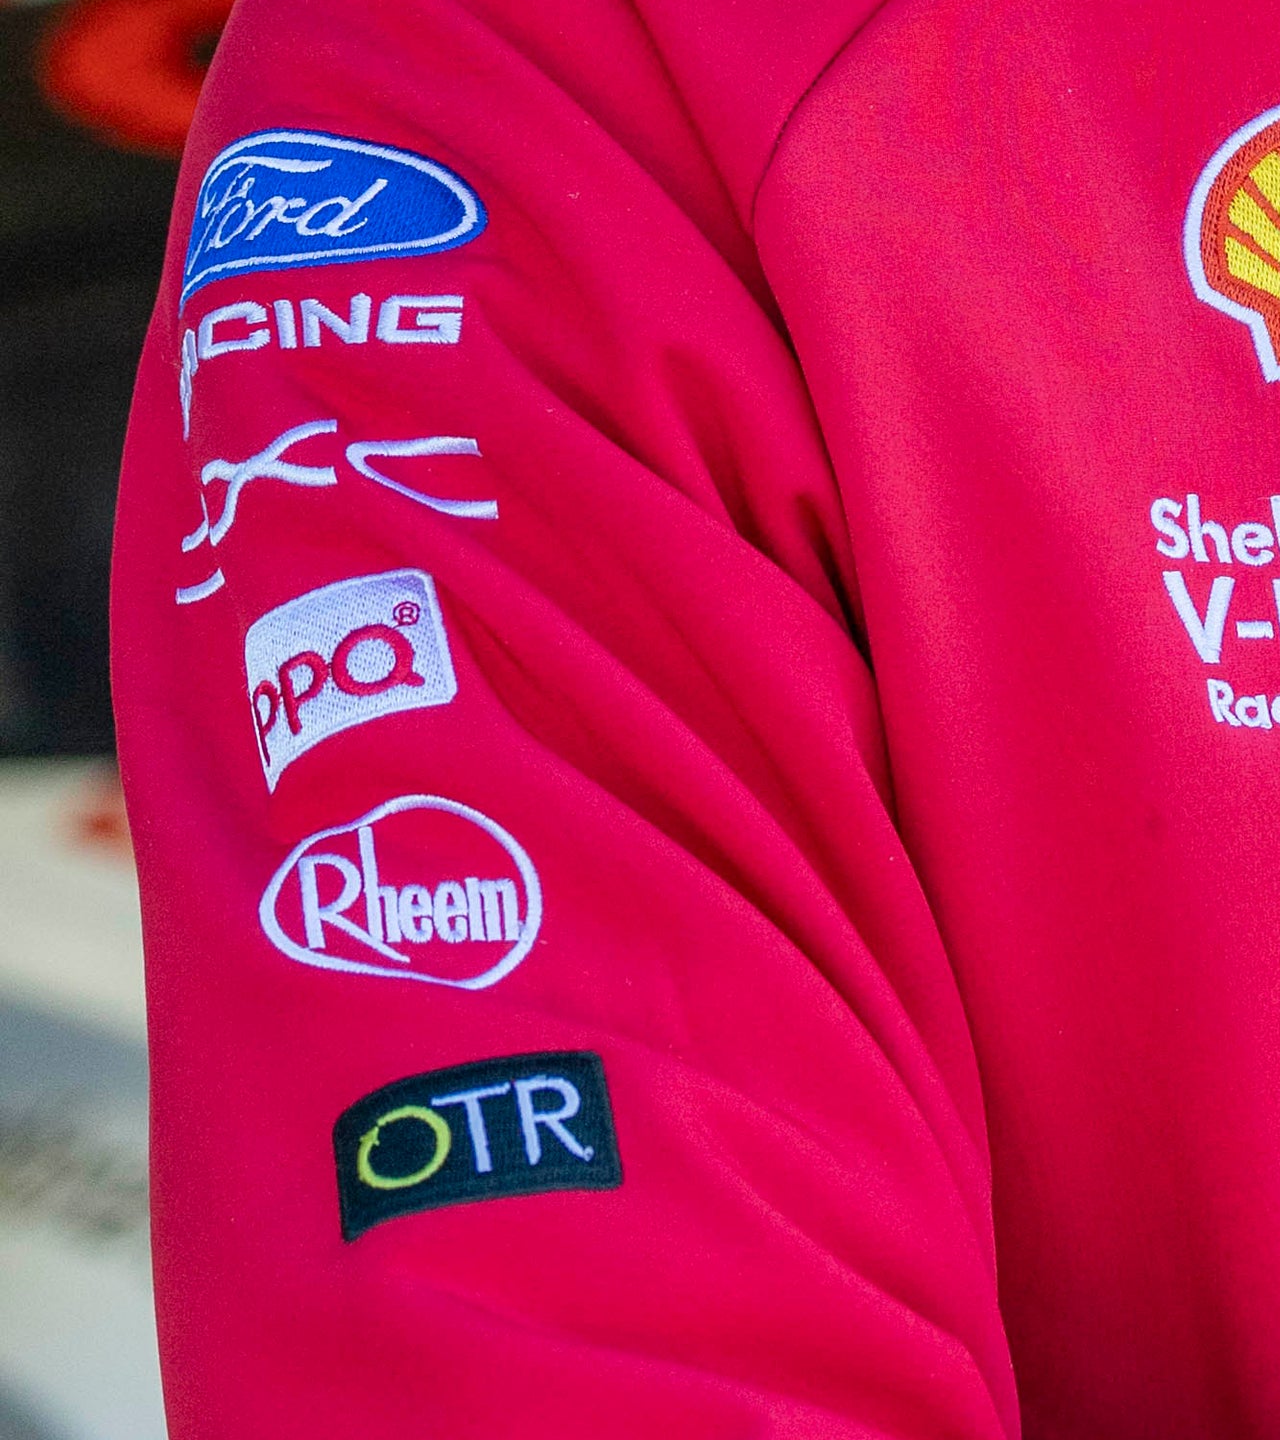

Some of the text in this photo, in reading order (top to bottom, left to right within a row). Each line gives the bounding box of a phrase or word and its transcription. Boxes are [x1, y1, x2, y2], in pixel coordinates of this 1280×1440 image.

[188, 155, 389, 276] Ford
[179, 292, 464, 376] CING
[299, 826, 521, 963] Rheem
[356, 1075, 595, 1191] OTR
